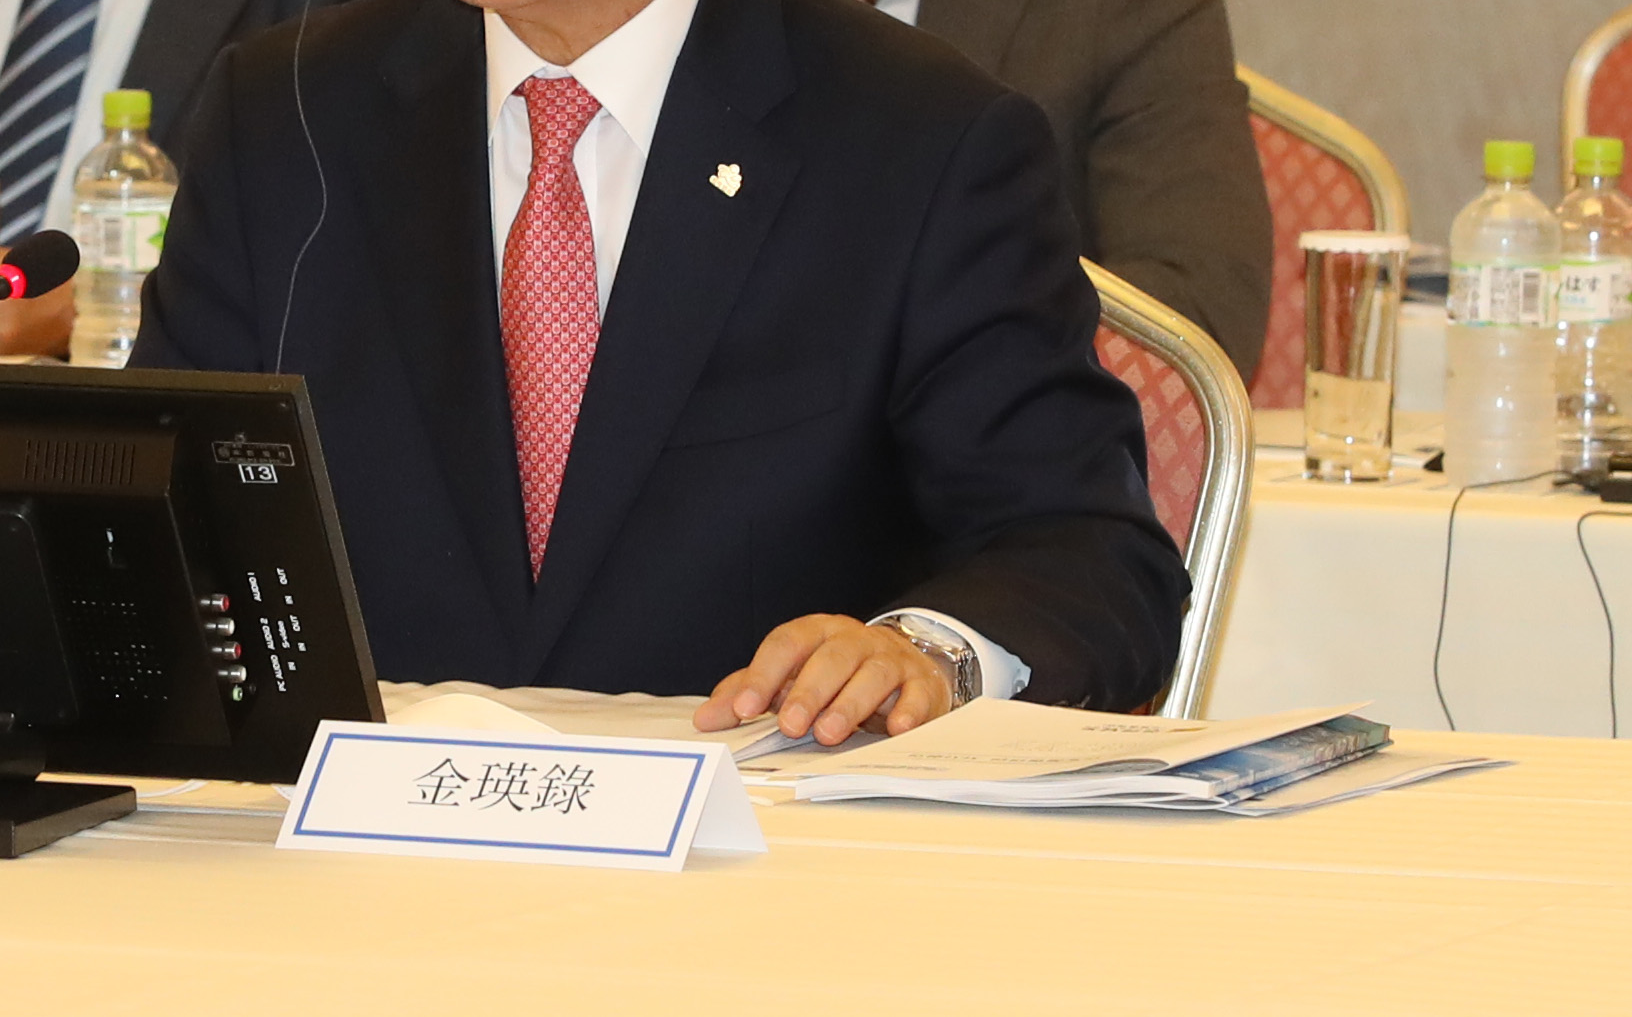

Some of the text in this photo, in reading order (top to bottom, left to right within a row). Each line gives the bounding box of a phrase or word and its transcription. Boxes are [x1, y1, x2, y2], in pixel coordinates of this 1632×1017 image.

[245, 466, 273, 480] 13
[276, 567, 288, 585] OUT
[248, 576, 262, 602] AUDIO
[284, 595, 294, 605] IN
[290, 614, 301, 632] OUT
[262, 625, 275, 650] AUDIO
[298, 642, 306, 652] IN
[270, 654, 287, 692] PC AUDIO
[288, 661, 297, 671] IN
